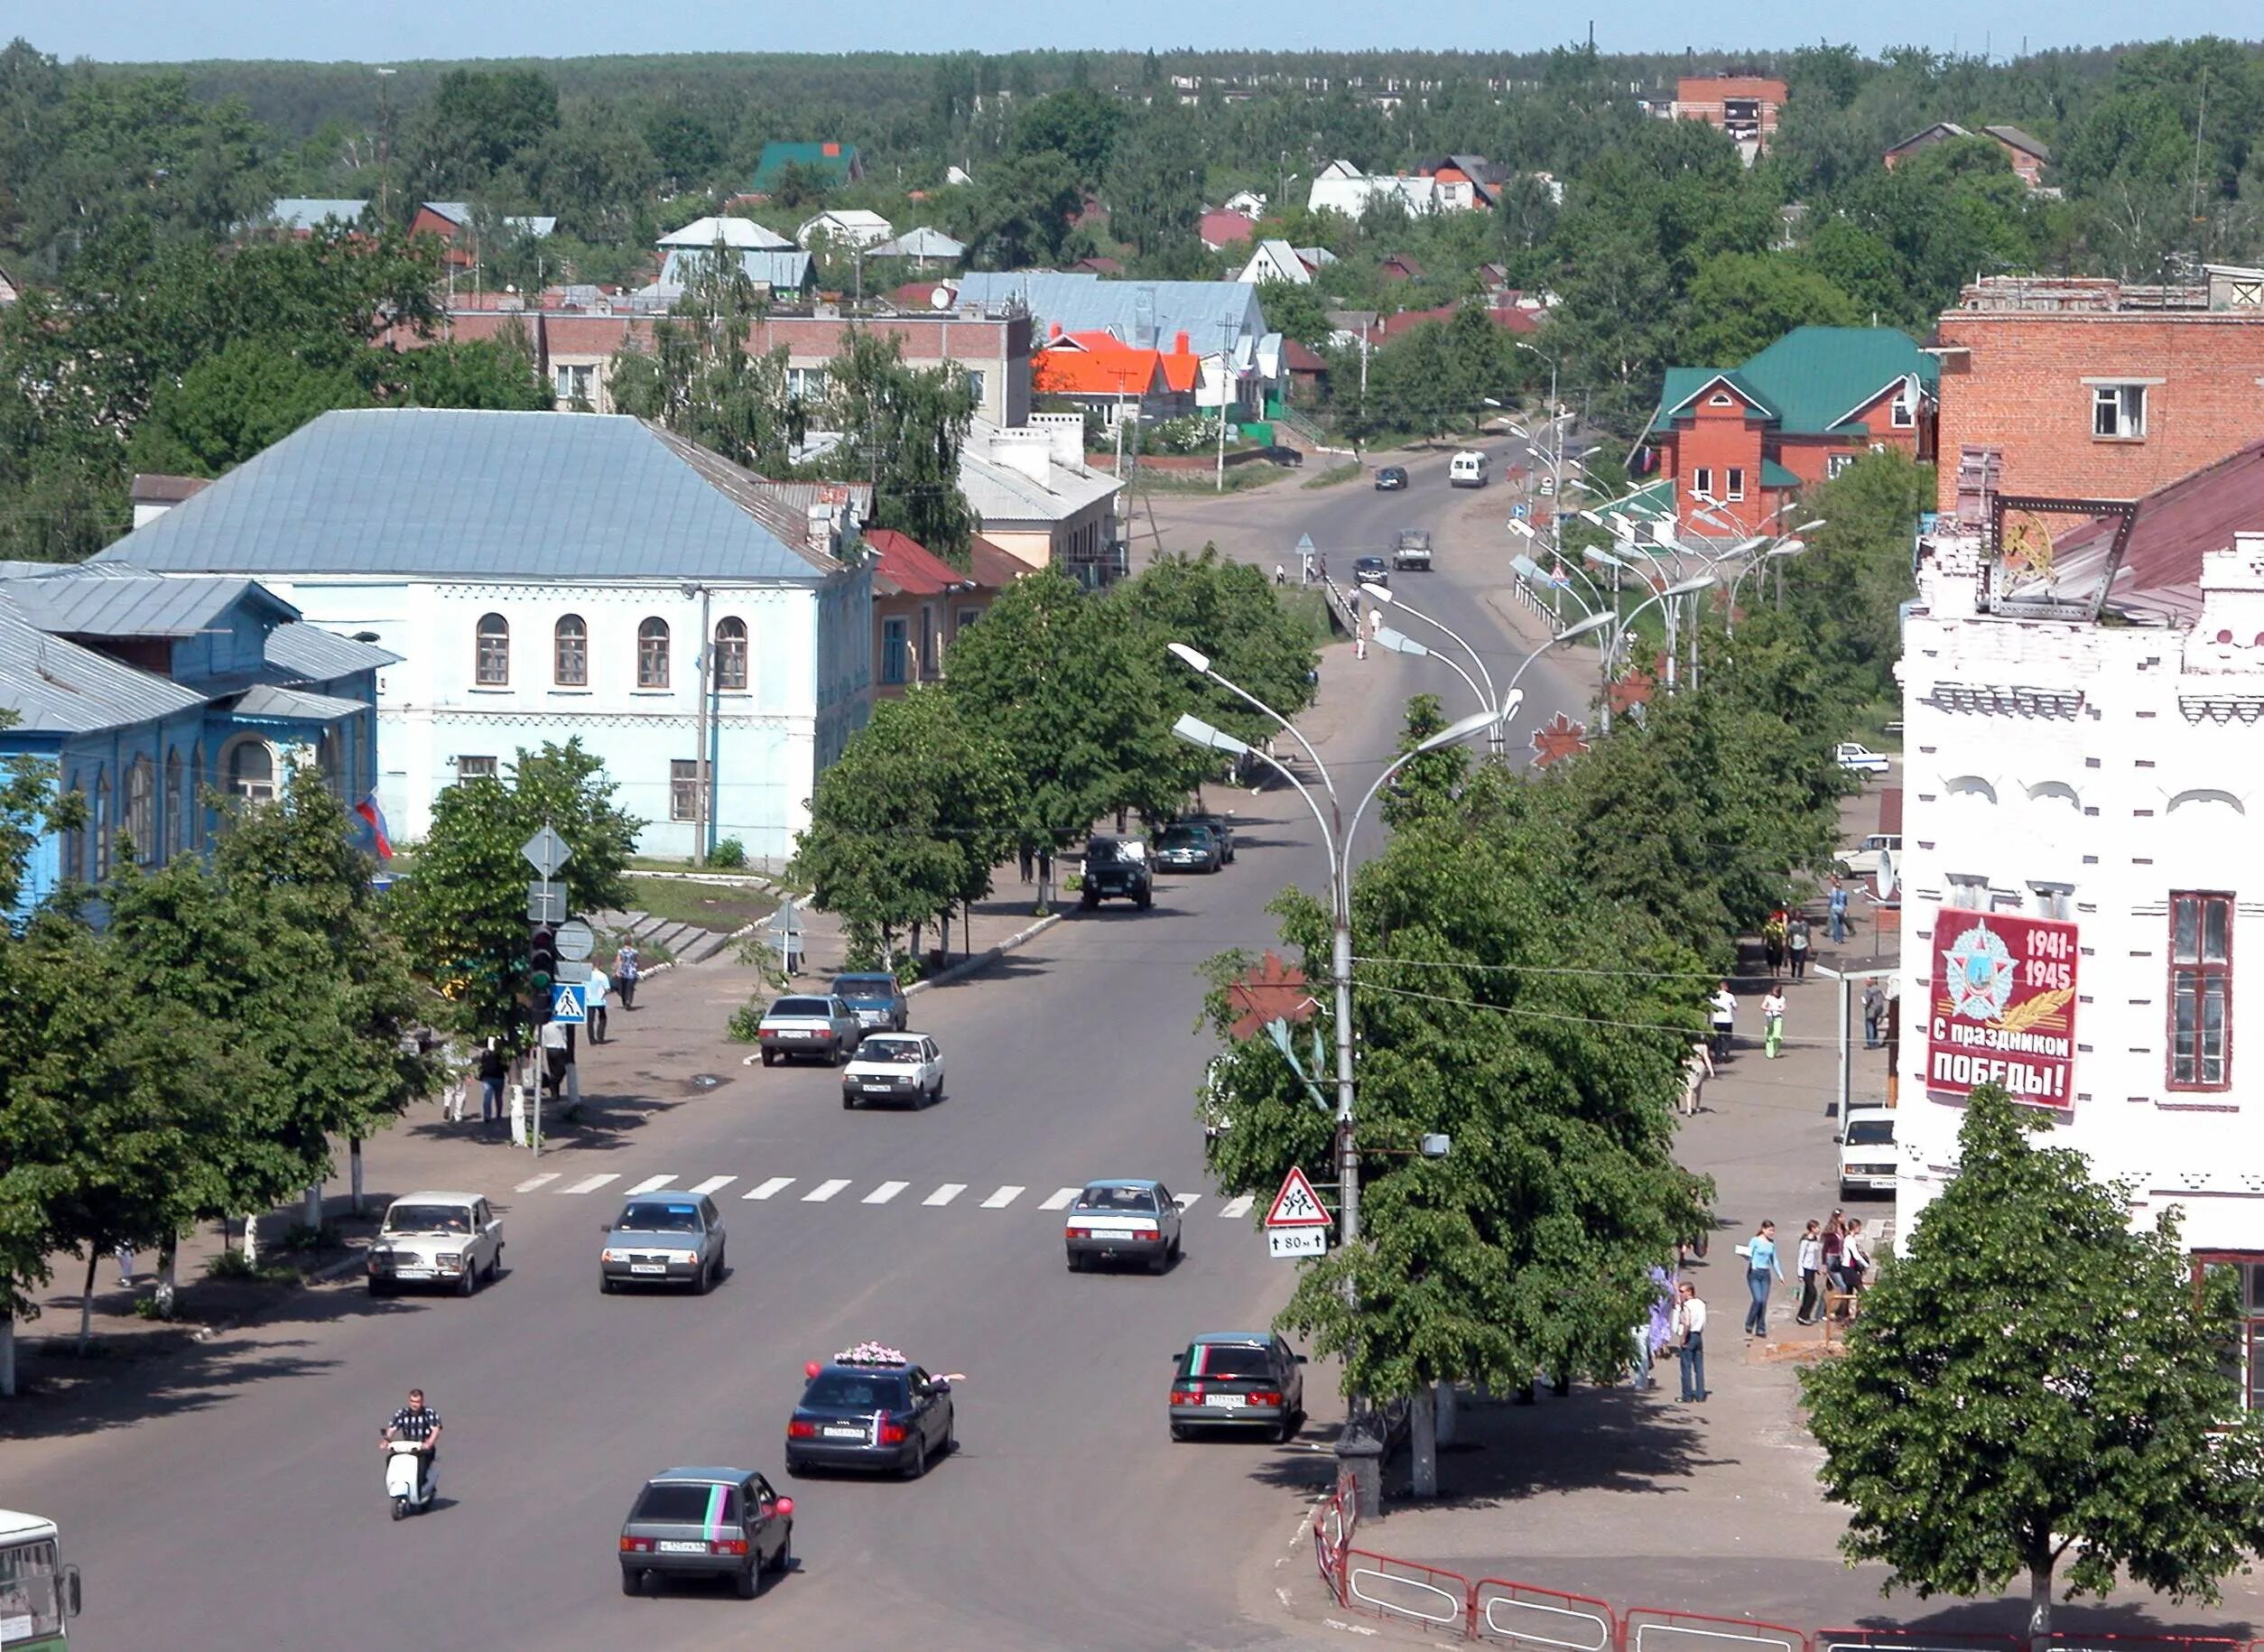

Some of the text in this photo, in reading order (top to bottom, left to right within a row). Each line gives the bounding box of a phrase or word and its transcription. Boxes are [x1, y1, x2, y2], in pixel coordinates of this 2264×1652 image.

[2027, 929, 2074, 959] 1941-
[2026, 960, 2071, 989] 1945
[1934, 1017, 2069, 1057] С праздником
[1934, 1052, 2065, 1098] ПОБЕДЫ!
